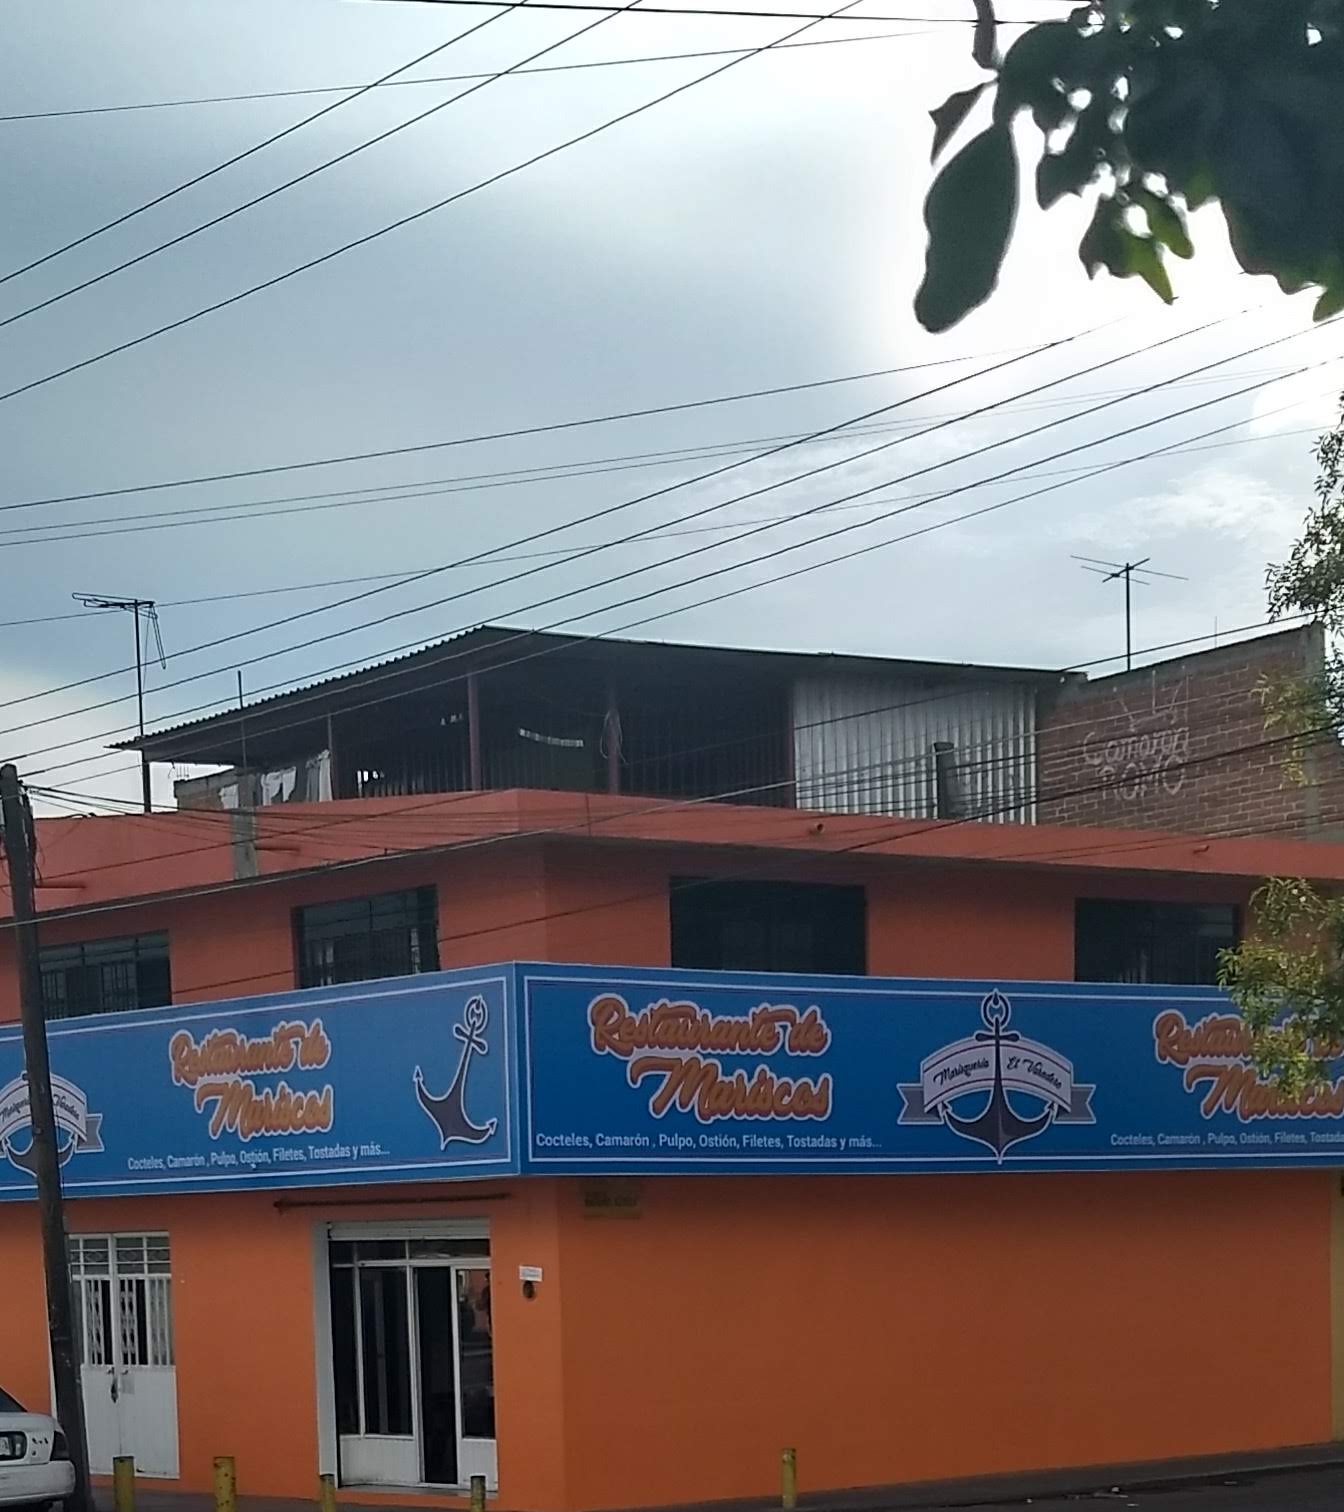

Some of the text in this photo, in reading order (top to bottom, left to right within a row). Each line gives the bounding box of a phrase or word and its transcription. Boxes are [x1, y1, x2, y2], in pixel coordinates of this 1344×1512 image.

[169, 1020, 306, 1089] Restaurante
[587, 993, 832, 1060] Restaurante de
[1153, 1009, 1309, 1068] Restau
[627, 1053, 832, 1125] Mariscos
[1007, 1056, 1020, 1071] El
[194, 1078, 334, 1142] Mariscos
[1111, 1133, 1156, 1146] Cocteles,
[1207, 1132, 1238, 1147] Pulpo,
[1274, 1131, 1308, 1145] Filetes,
[128, 1155, 166, 1171] Cocteles,
[210, 1151, 239, 1167] Pulpo,
[273, 1146, 306, 1163] Filetes,
[308, 1143, 350, 1160] Tostadas
[536, 1133, 593, 1149] Cocteles,
[595, 1133, 650, 1148] Camarón
[659, 1134, 696, 1150] Pulpo,
[699, 1134, 740, 1150] Ostión,
[742, 1134, 784, 1150] Filetes,
[787, 1135, 837, 1149] Tostadas
